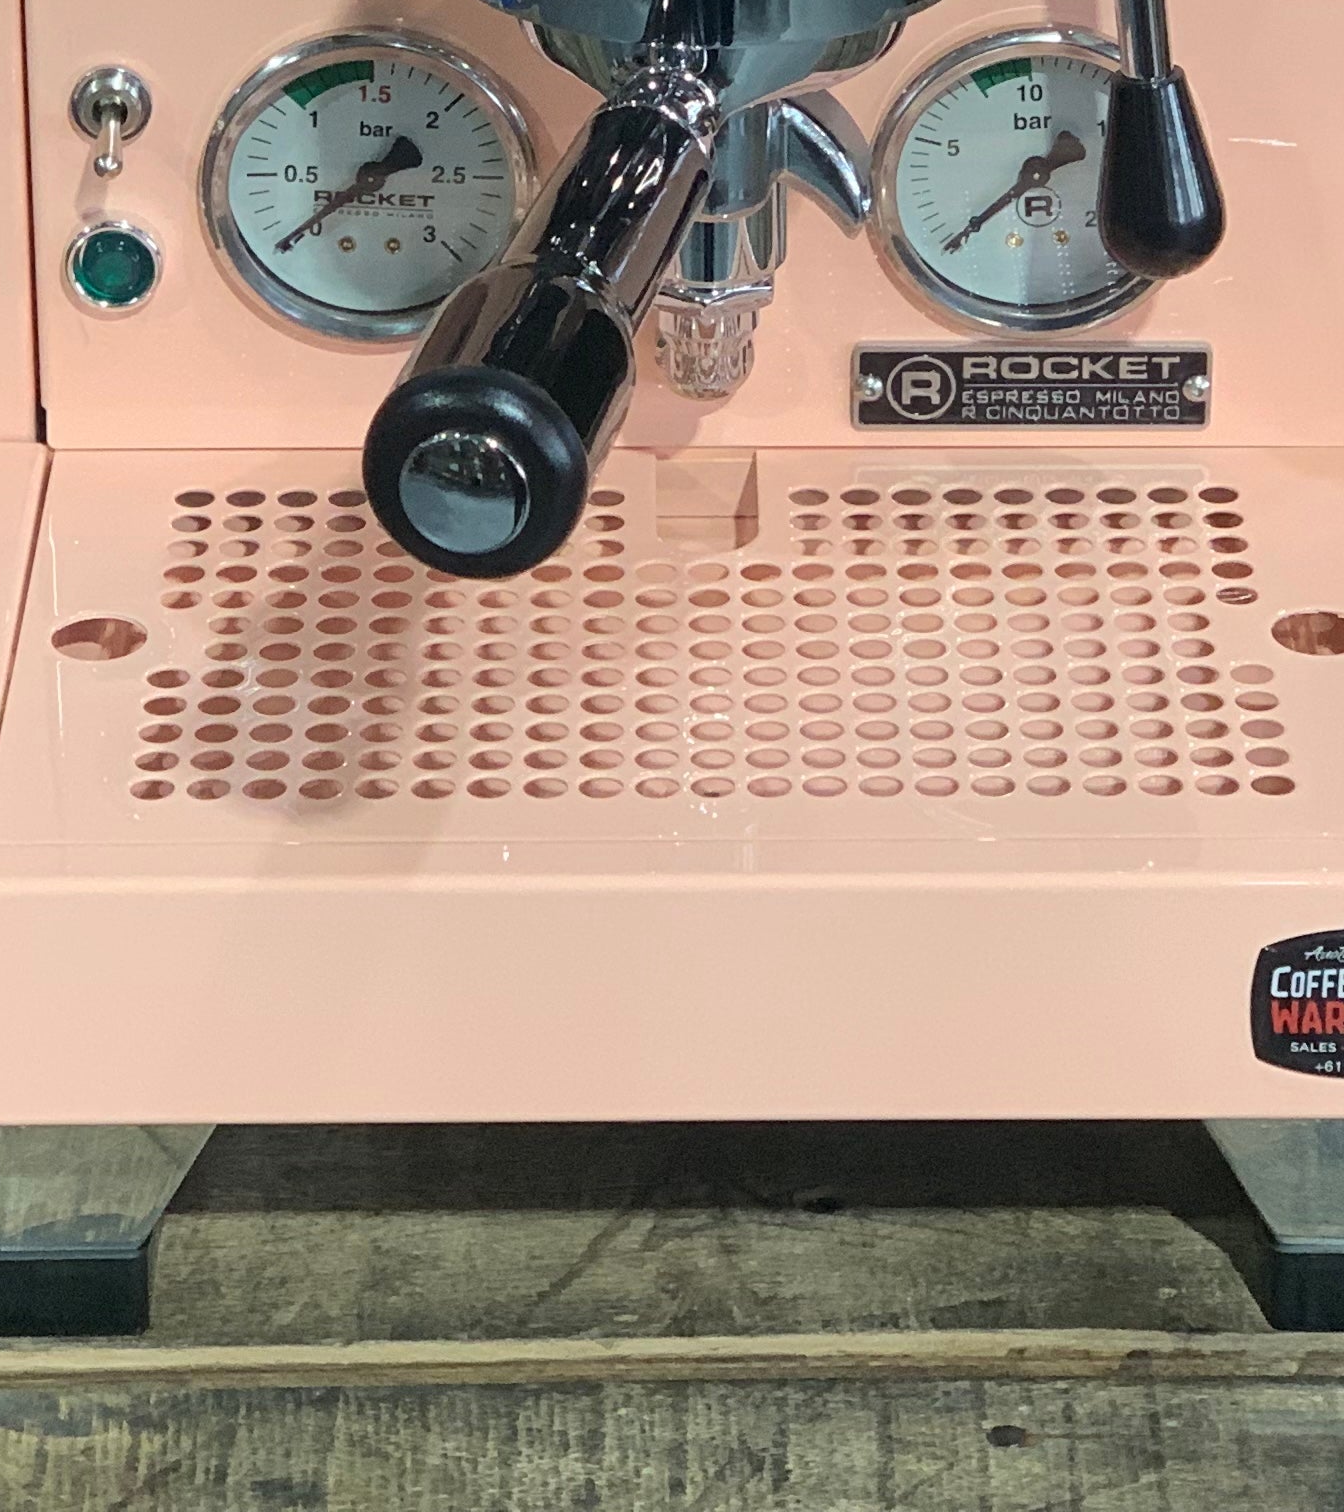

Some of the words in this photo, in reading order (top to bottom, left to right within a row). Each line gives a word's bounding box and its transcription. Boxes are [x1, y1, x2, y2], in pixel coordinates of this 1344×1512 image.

[358, 84, 392, 104] 1.5
[1016, 84, 1044, 102] 10
[308, 111, 318, 129] 1
[359, 120, 393, 138] bar
[425, 111, 440, 129] 2
[1013, 112, 1052, 131] bar
[947, 139, 961, 157] 5
[283, 165, 319, 184] 0.5
[431, 165, 466, 185] 2.5
[314, 190, 435, 207] RCKET
[1024, 195, 1053, 217] R
[309, 222, 323, 237] 0
[422, 225, 437, 243] 3
[962, 356, 1181, 380] ROCKET
[901, 371, 942, 405] R
[961, 390, 1080, 404] ESPRESSO
[1095, 389, 1180, 404] MILANO
[961, 405, 977, 420] R
[986, 405, 1181, 422] CINQUANTOTTO
[1290, 1042, 1337, 1054] SALES
[1314, 1060, 1341, 1073] +61
